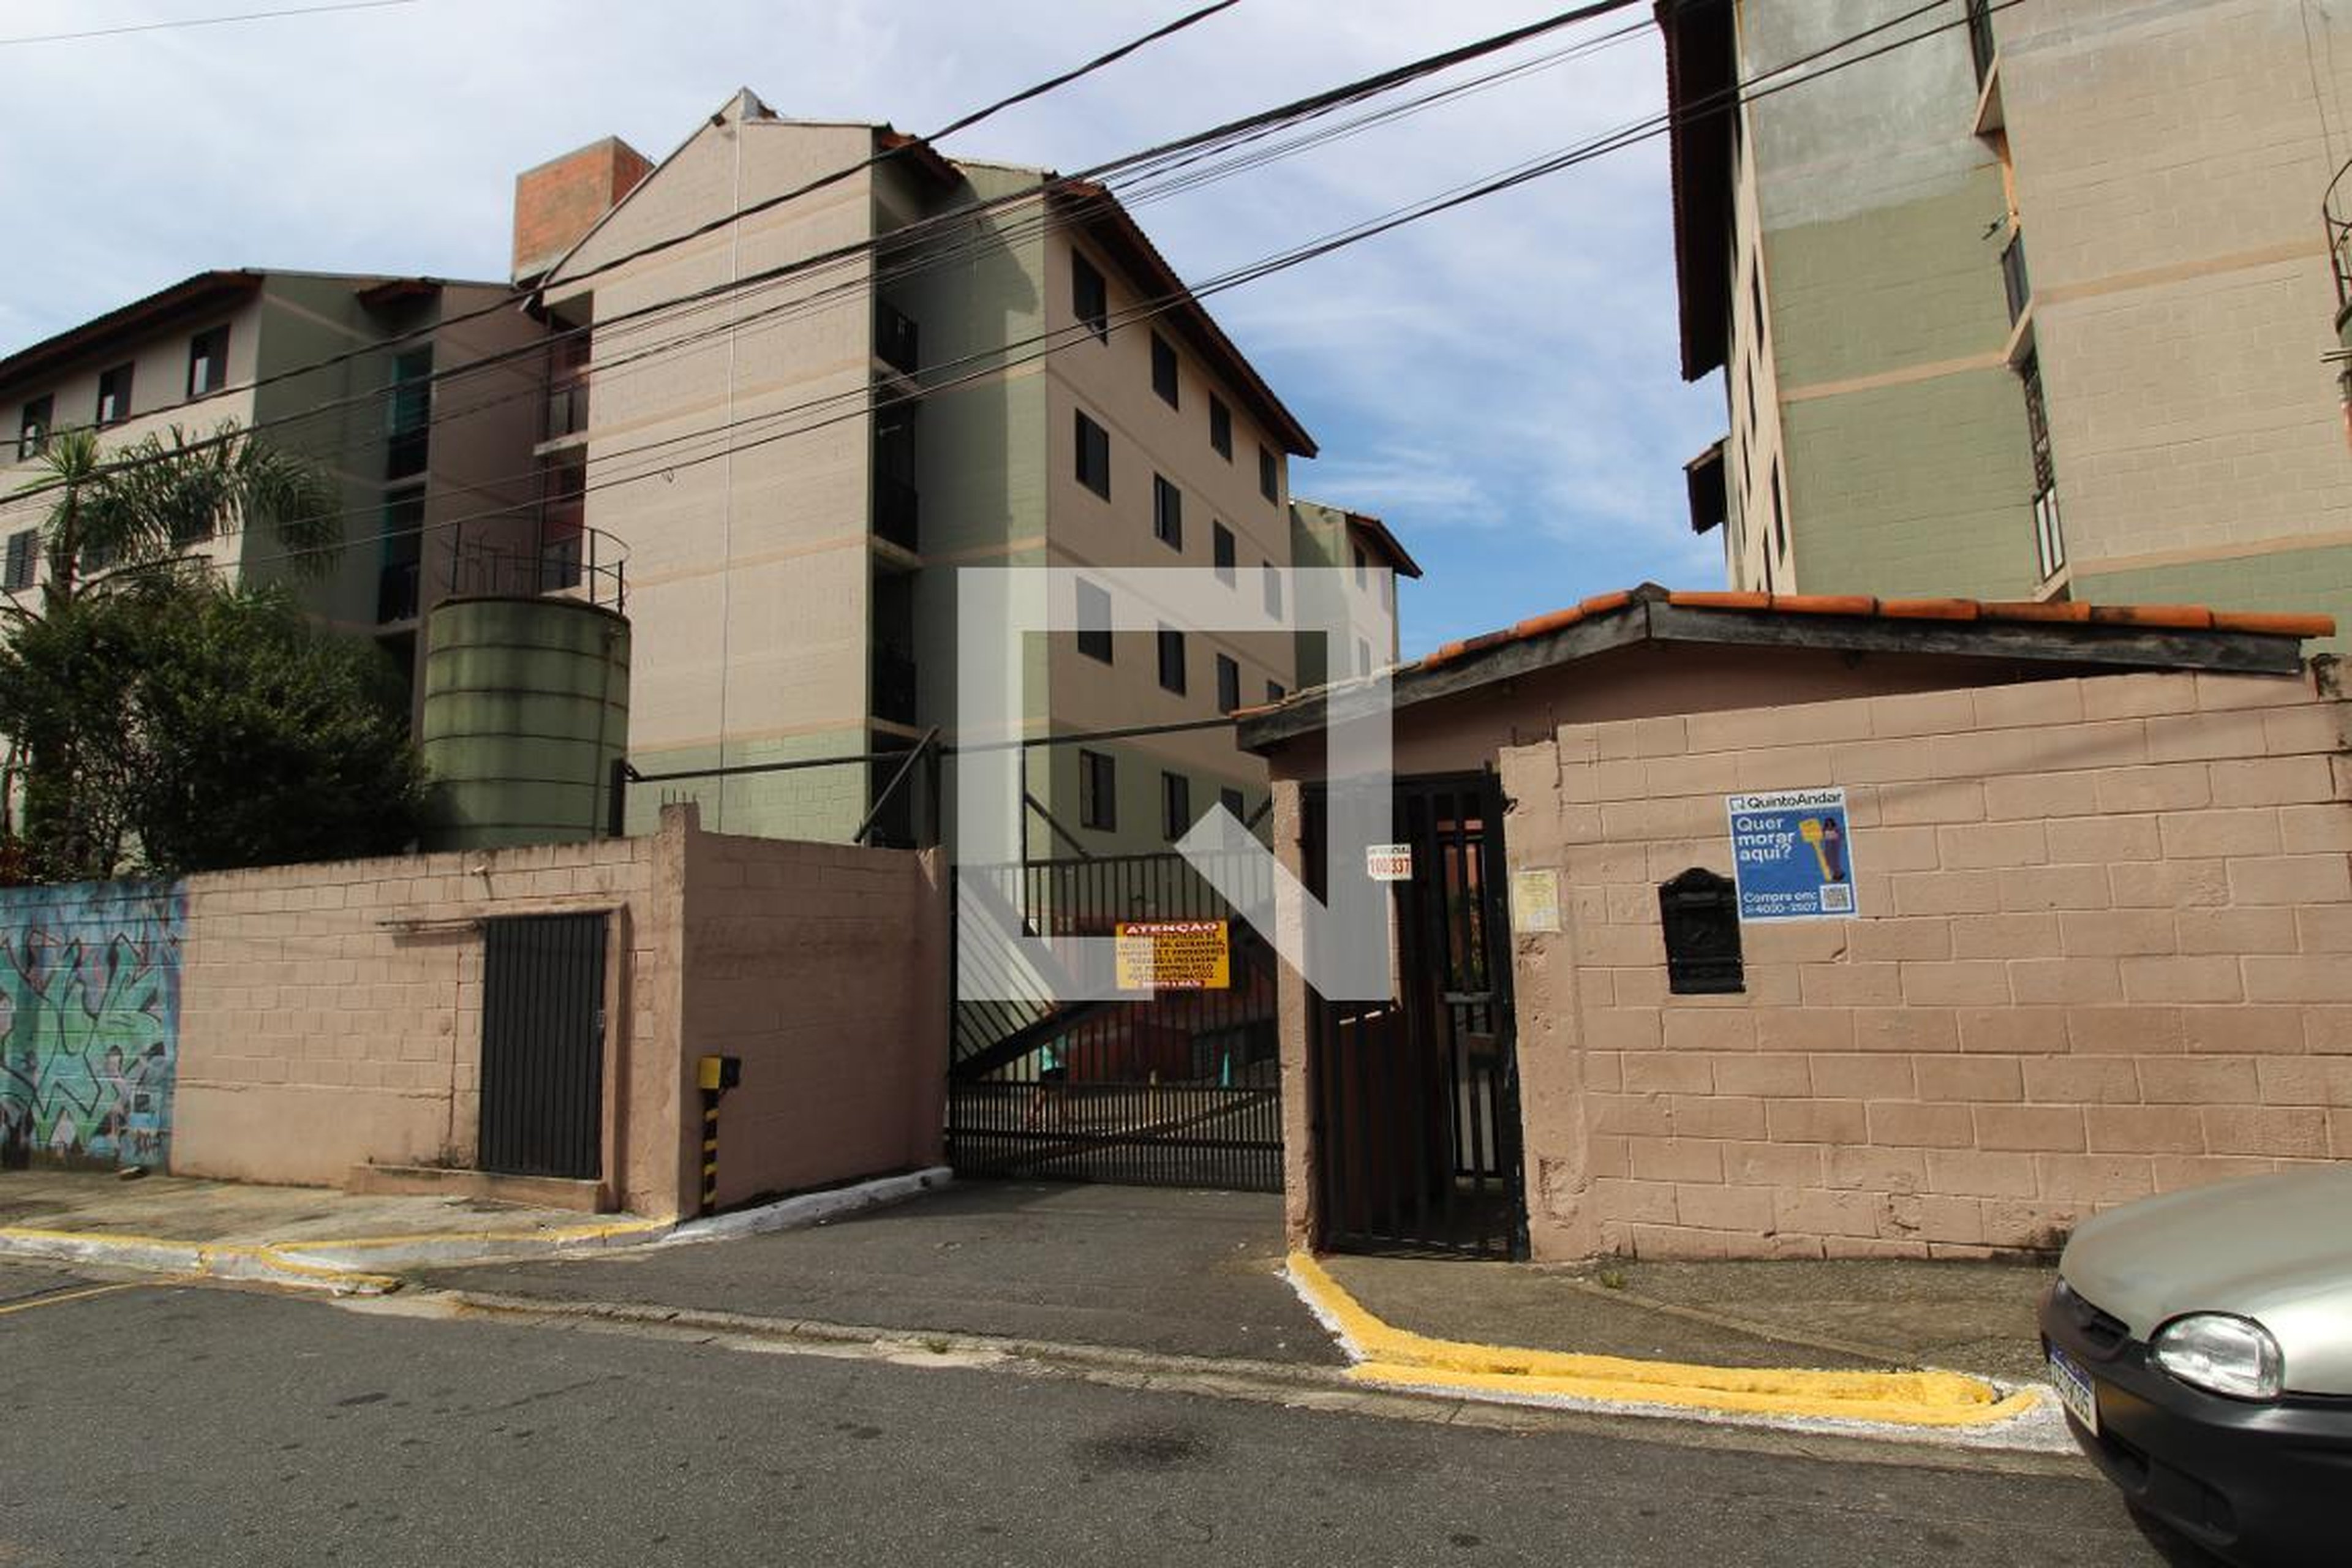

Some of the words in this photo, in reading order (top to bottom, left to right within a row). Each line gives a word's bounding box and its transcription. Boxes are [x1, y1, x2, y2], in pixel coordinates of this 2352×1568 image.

[1748, 792, 1841, 809] QuintoAndar
[1737, 816, 1784, 832] Quer
[1738, 831, 1795, 846] morar
[1740, 843, 1792, 863] aqui?
[1743, 892, 1793, 903] Compre
